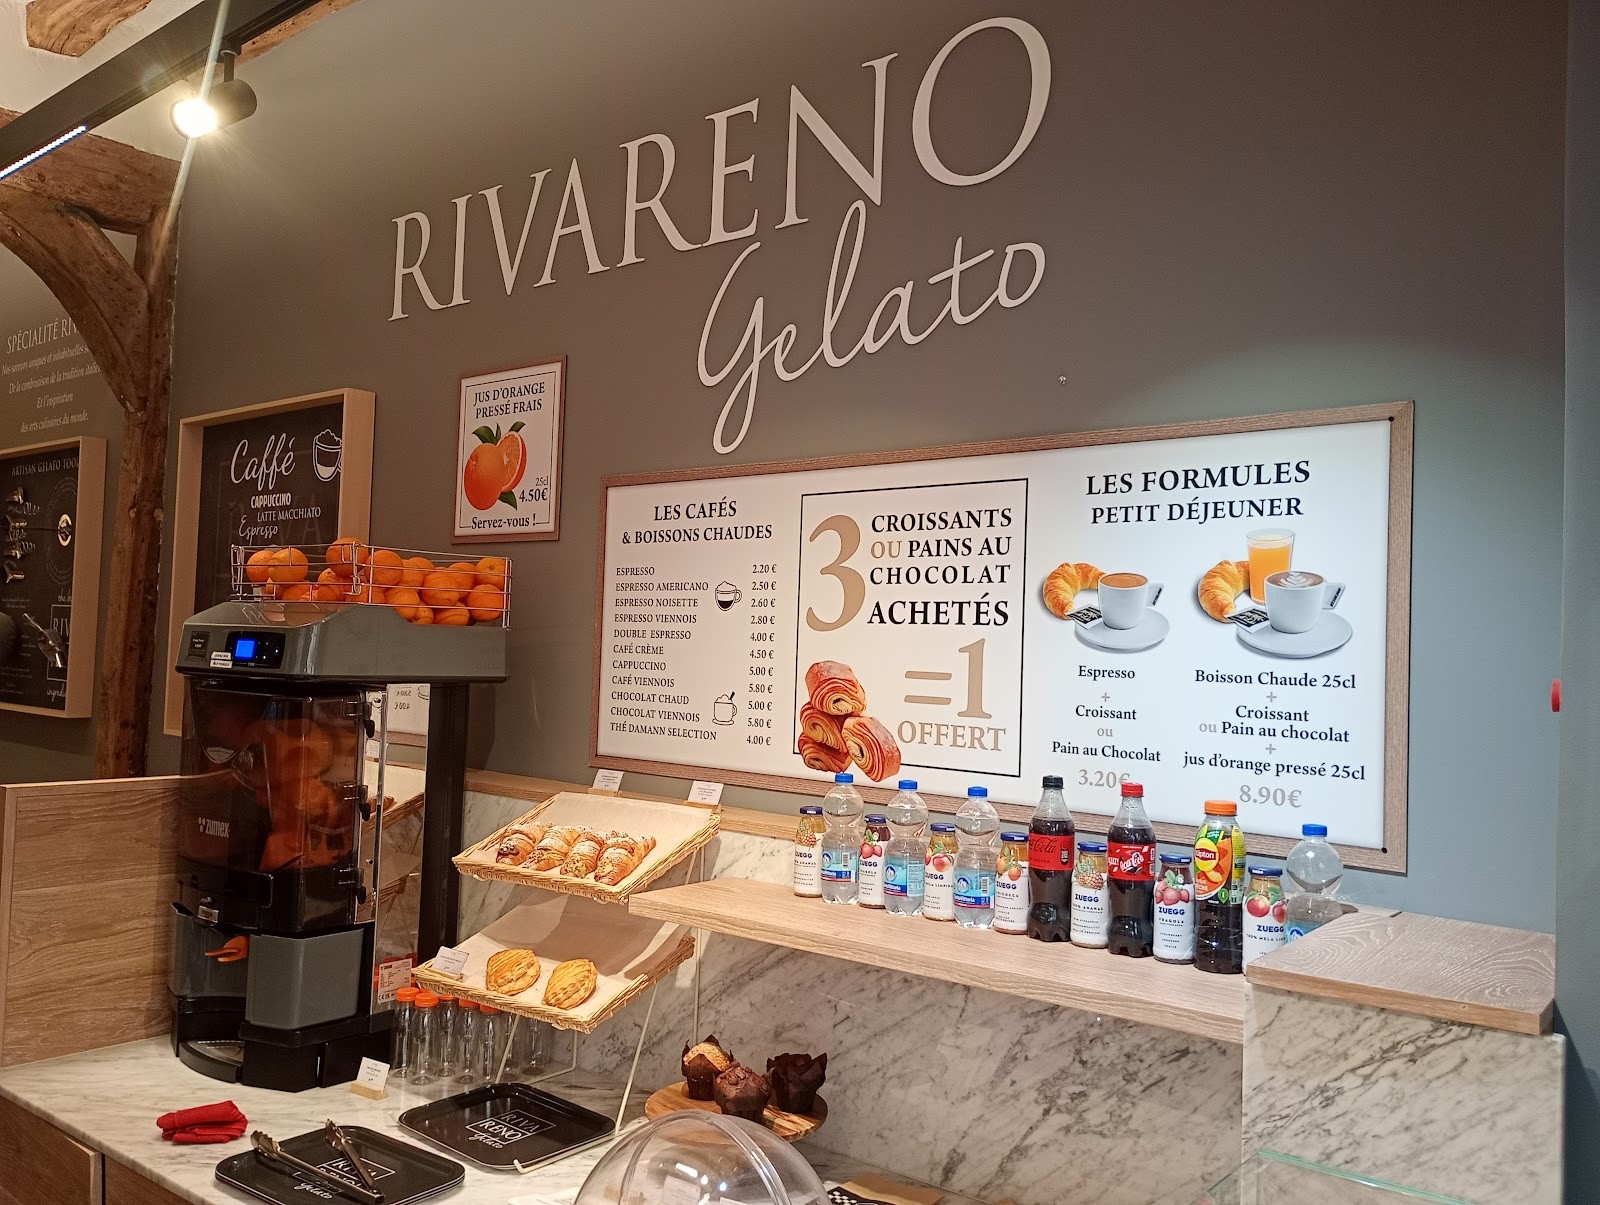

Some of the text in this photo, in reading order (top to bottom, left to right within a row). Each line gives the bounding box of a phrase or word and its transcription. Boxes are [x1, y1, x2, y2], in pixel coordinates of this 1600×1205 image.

[388, 16, 1052, 322] RIVARENO
[6, 318, 59, 354] SPÉCIALITÉ
[473, 381, 546, 406] JUS D'ORANGE
[475, 398, 543, 419] PRESSÉ FRAIS
[11, 464, 36, 476] ARTISAN
[37, 459, 61, 473] GELATO
[230, 432, 296, 491] Caffé
[535, 475, 549, 487] 25cl
[1086, 460, 1311, 496] LES FORMULES
[250, 492, 292, 509] CAPPUCCINO
[518, 487, 548, 503] 4.50€
[257, 506, 321, 523] LATTE MACCHIATO
[654, 496, 737, 521] LES CAFÉS
[1091, 496, 1304, 525] PETIT DÉJEUNER
[238, 514, 279, 546] Espresso
[471, 513, 536, 530] Servez-vous !
[871, 507, 1013, 533] CROISSANTS
[622, 524, 773, 545] & BOISSONS CHAUDES
[870, 536, 1013, 559] OU PAINS AU
[616, 563, 777, 576] ESPRESSO 2.20 €
[806, 515, 866, 632] 3
[870, 564, 1011, 585] CHOCOLAT
[615, 581, 777, 592] ESPRESSO AMERICANO 2.50 €
[615, 598, 776, 608] ESPRESSO NOISETTE 2.60 €
[866, 592, 1009, 627] ACHETÉS
[614, 613, 776, 625] ESPRESSO VIENNOIS 2.80 €
[613, 629, 775, 642] DOUBLE ESPRESSO 4.00 €
[613, 643, 774, 659] CAFÉ CRÈME 4.50 €
[612, 660, 774, 677] CAPPUCCINO 5.00 €
[1078, 665, 1136, 681] Espresso
[612, 674, 773, 694] CAFÉ VIENNOIS 5.80 €
[1195, 669, 1356, 689] Boisson Chaude 25cl
[611, 691, 773, 711] CHOCOLAT CHAUD 5.00 €
[610, 706, 772, 729] CHOCOLAT VIENNOIS 5.80 €
[1075, 704, 1137, 720] Croissant
[1235, 705, 1309, 722] Croissant
[610, 722, 771, 746] THÉ DAMANN SELECTION 4.00 €
[897, 720, 1006, 751] OFFERT
[1097, 727, 1113, 737] ou
[1199, 721, 1350, 743] ou Pain au chocolat
[1052, 741, 1161, 762] Pain au Chocolat
[1183, 751, 1366, 780] jus d'orange pressé 25cl
[1239, 784, 1302, 808] 8.90€
[996, 880, 1017, 890] ZUEGG
[1074, 893, 1100, 903] ZUEGG
[1158, 906, 1186, 916] ZUEGG
[1256, 924, 1285, 933] ZUEGG
[479, 1120, 522, 1140] RENO
[500, 1113, 540, 1132] RIVA
